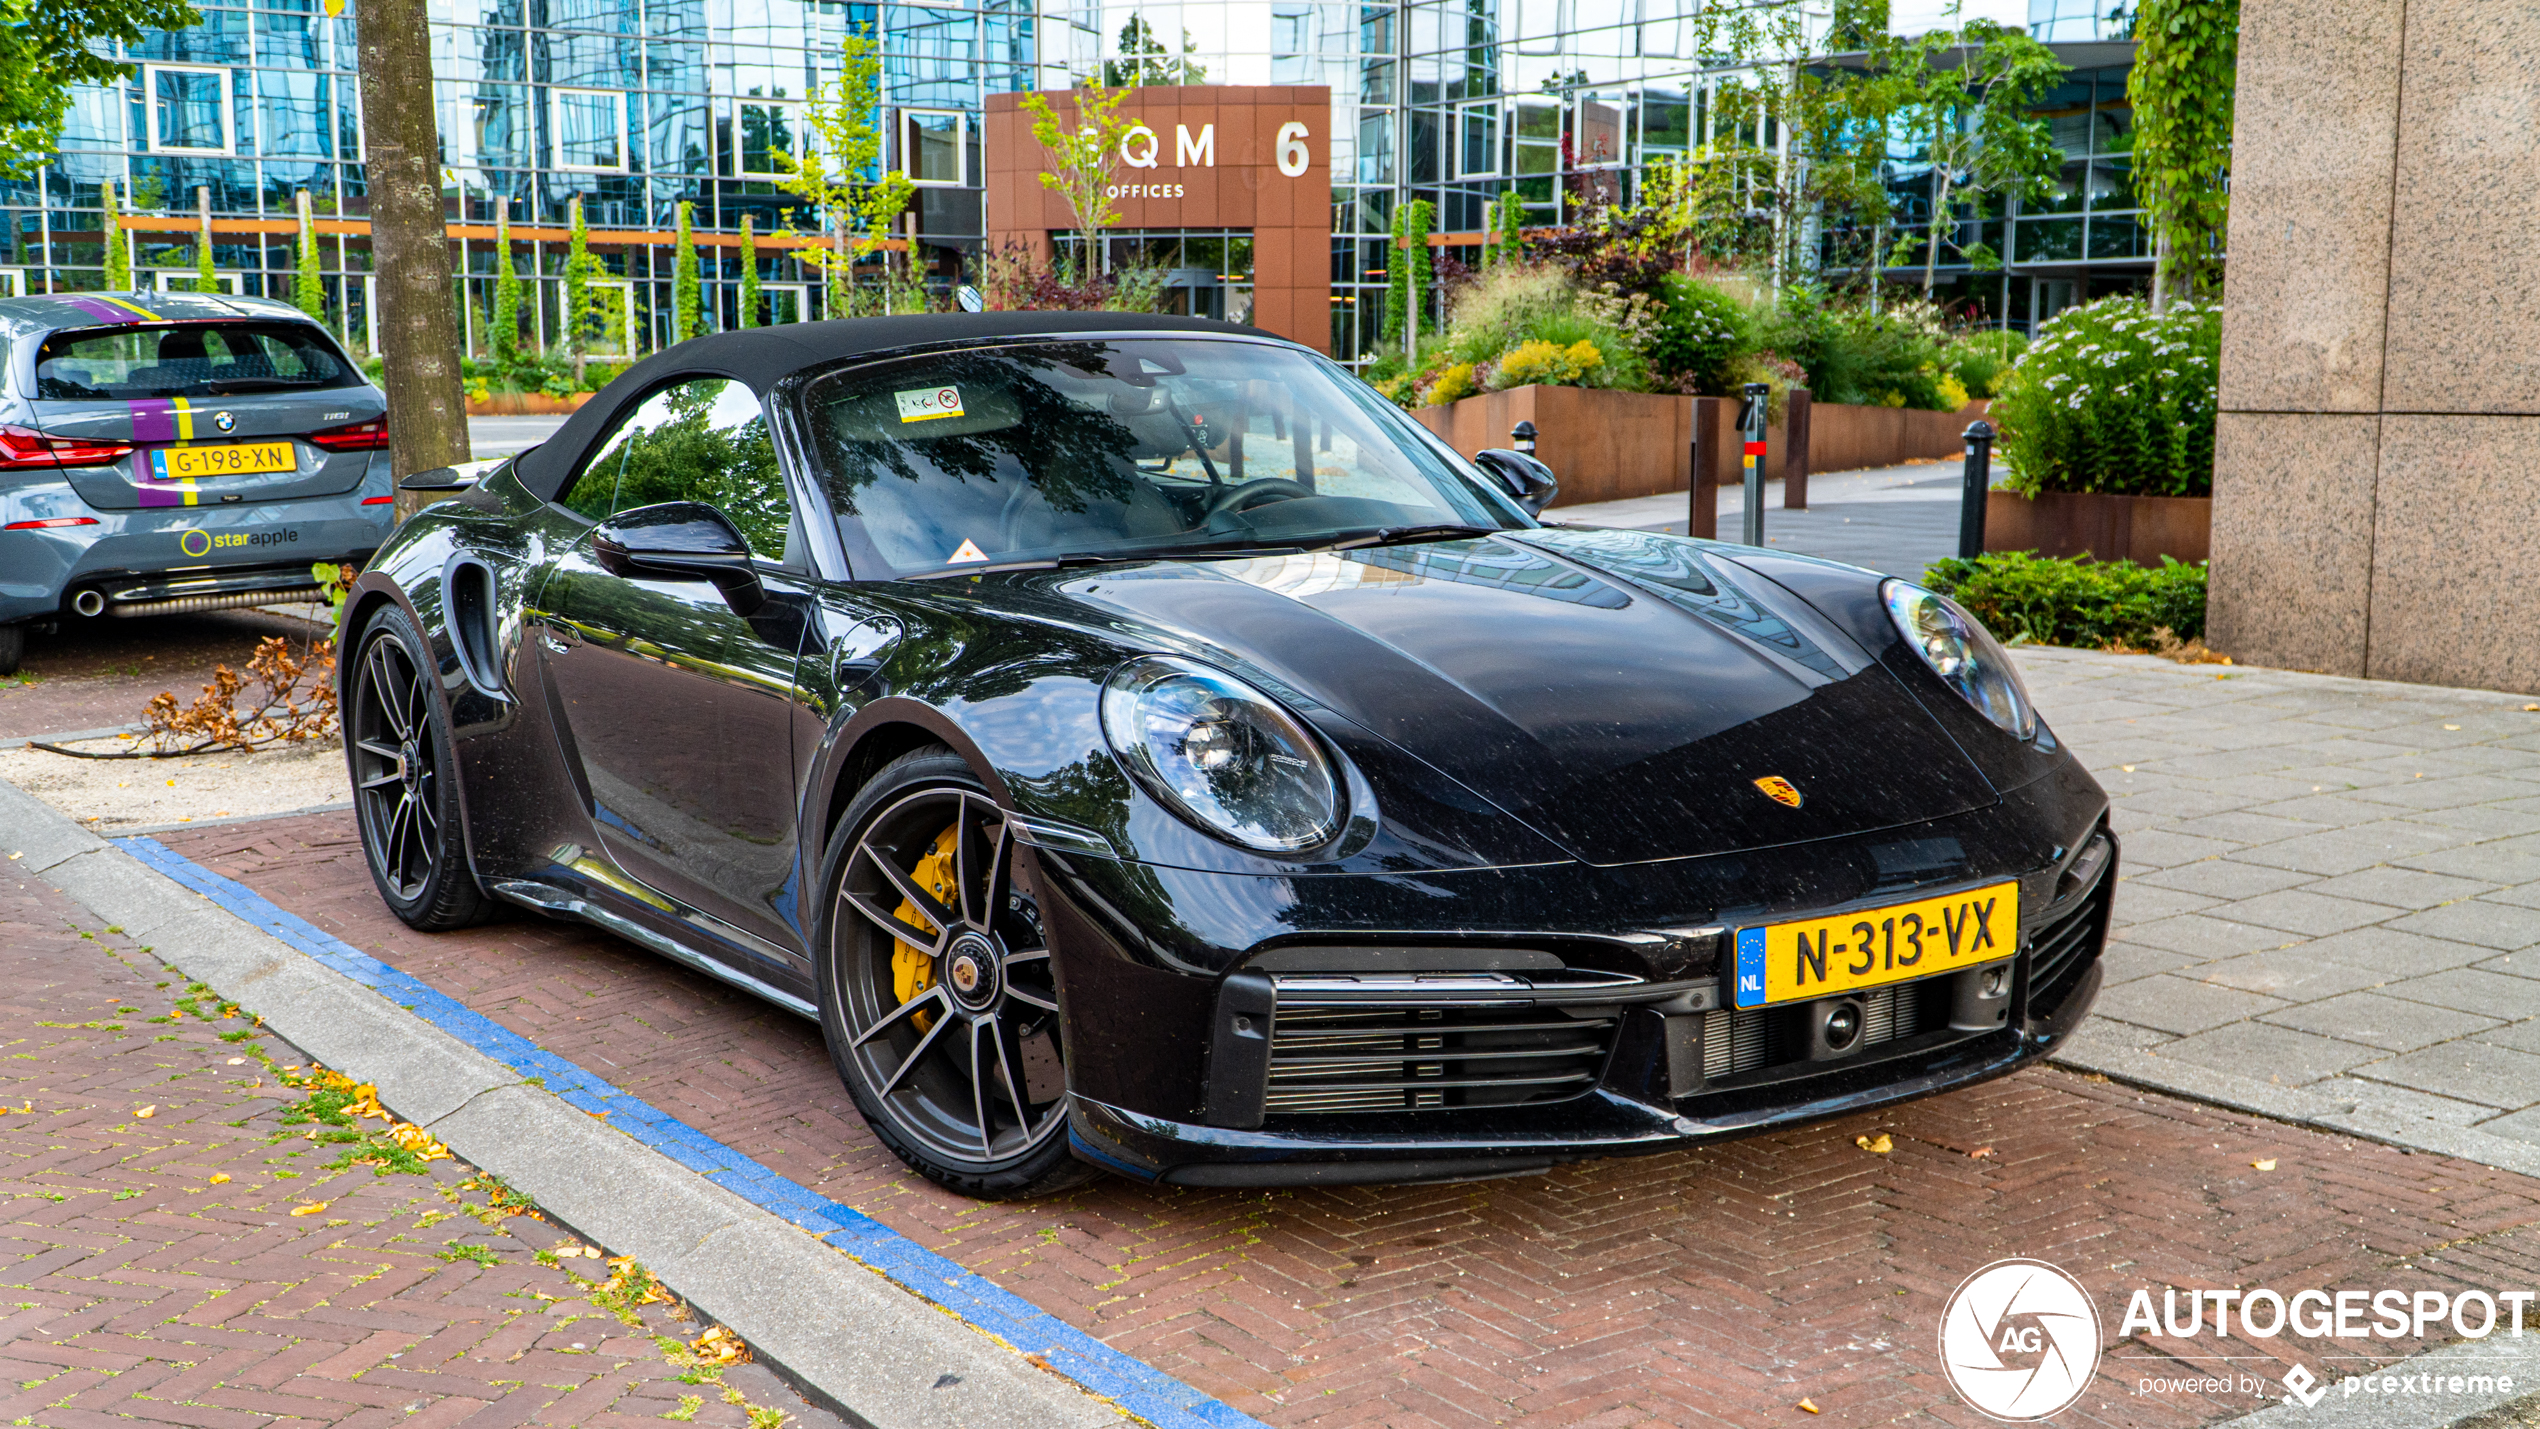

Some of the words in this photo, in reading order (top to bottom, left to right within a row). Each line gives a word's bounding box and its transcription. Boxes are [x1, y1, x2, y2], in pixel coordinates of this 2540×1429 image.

[1276, 121, 1310, 177] 6
[1106, 184, 1185, 199] OFFICES
[176, 447, 284, 472] G-198-XN
[214, 528, 298, 548] starapple
[1795, 897, 1998, 987] N-313-VX
[1740, 975, 1762, 993] NL
